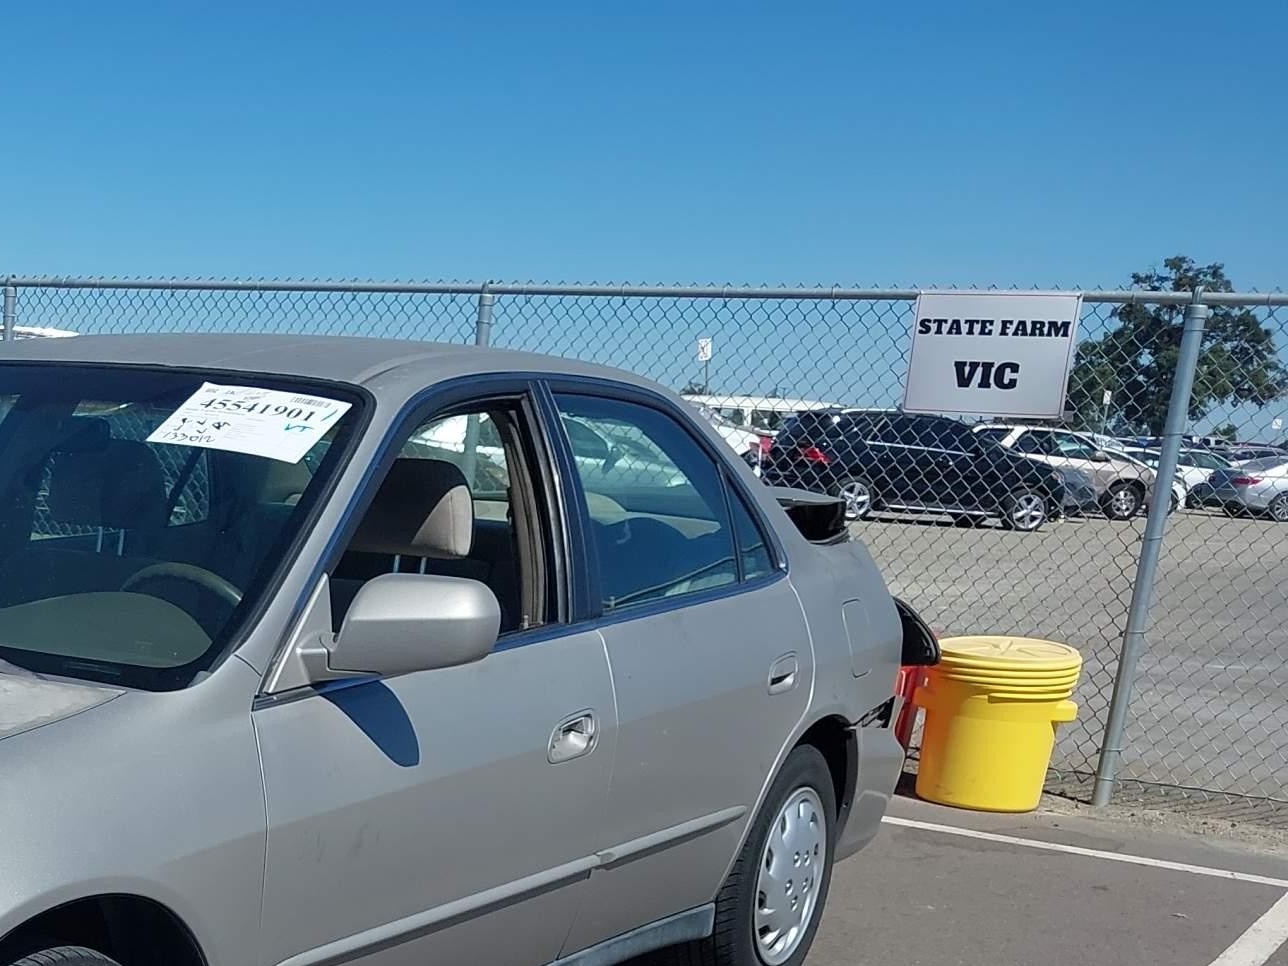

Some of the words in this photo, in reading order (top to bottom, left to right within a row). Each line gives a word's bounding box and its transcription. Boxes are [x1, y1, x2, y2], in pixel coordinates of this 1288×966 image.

[918, 318, 994, 336] STATE
[999, 320, 1071, 338] FARM
[954, 361, 1020, 390] VIC
[199, 398, 316, 422] 45541901
